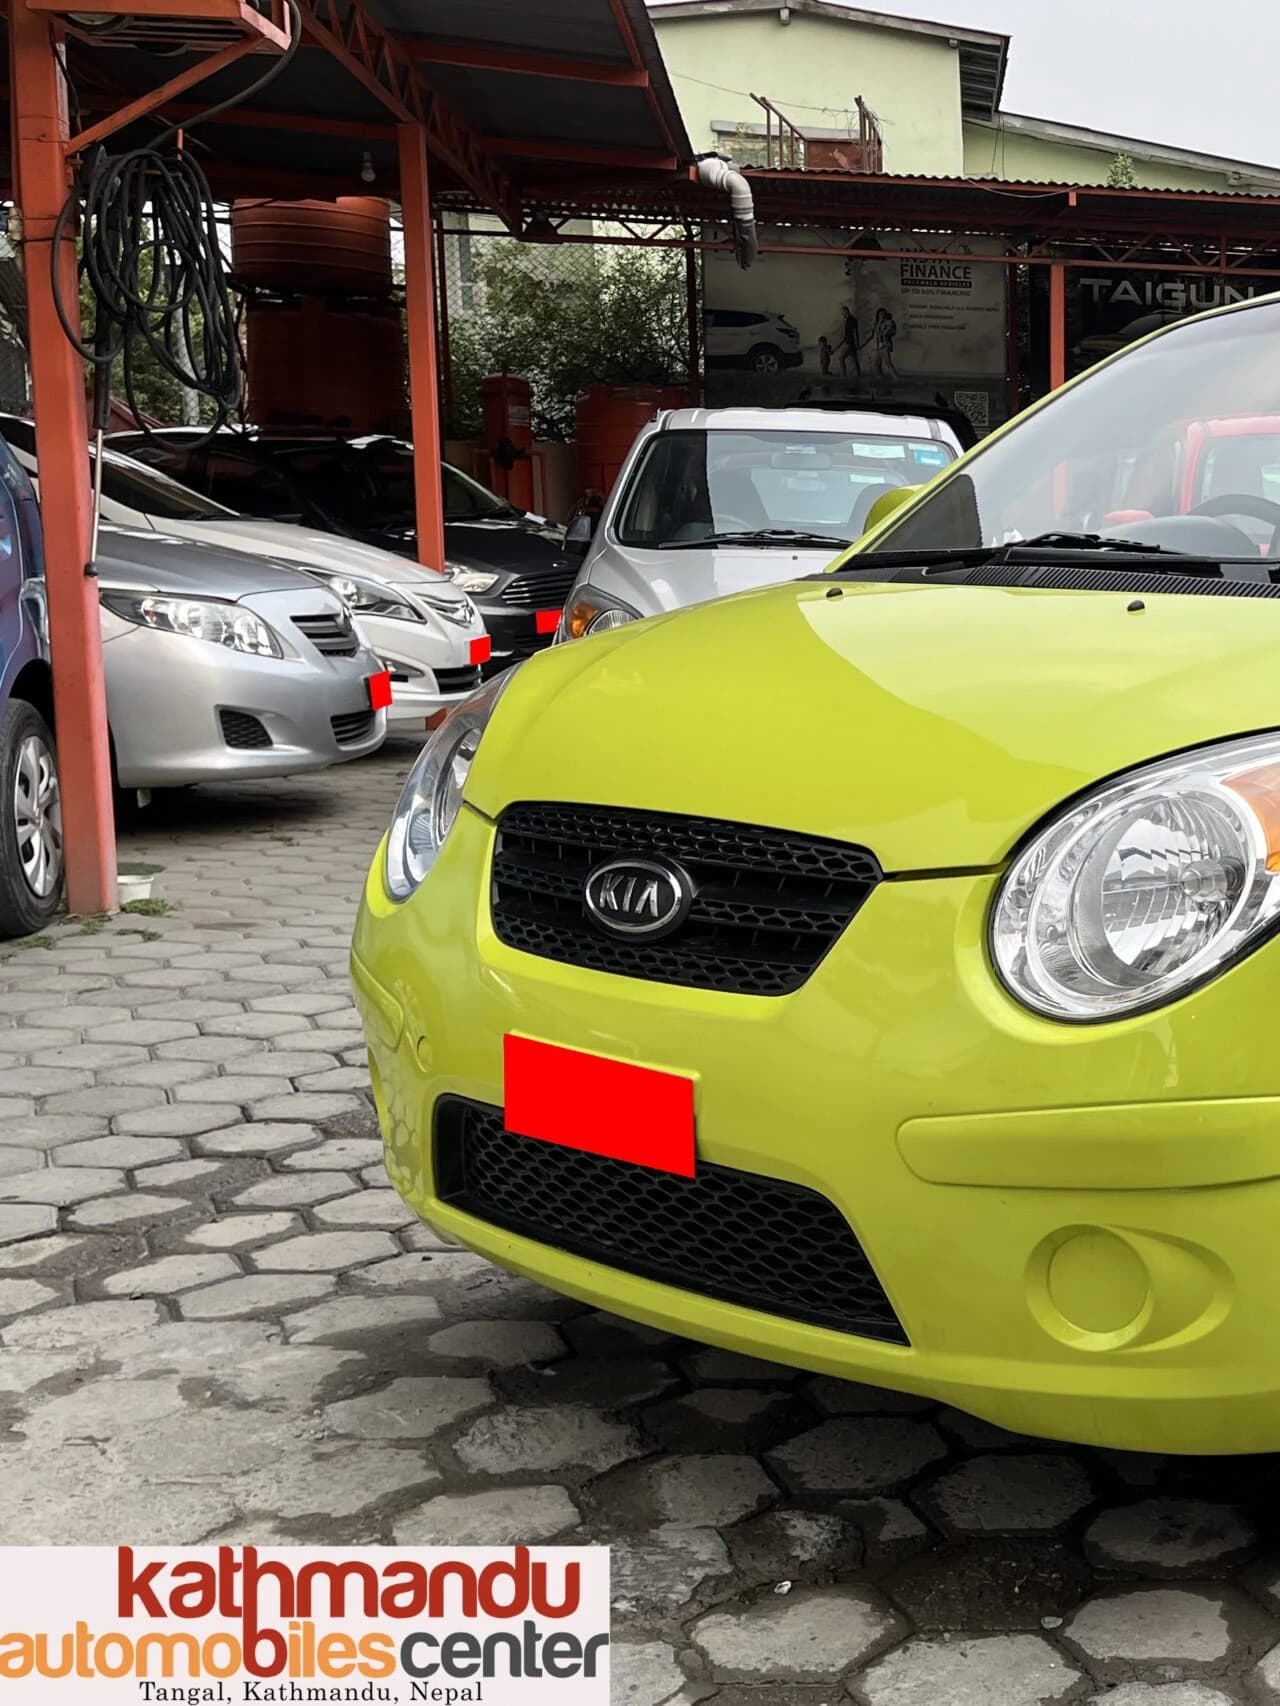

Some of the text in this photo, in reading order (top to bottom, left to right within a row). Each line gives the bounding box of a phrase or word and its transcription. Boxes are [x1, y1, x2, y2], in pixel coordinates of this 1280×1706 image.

[900, 263, 972, 279] FINANCE
[1080, 278, 1255, 309] TAIGUN
[599, 872, 659, 917] KIA
